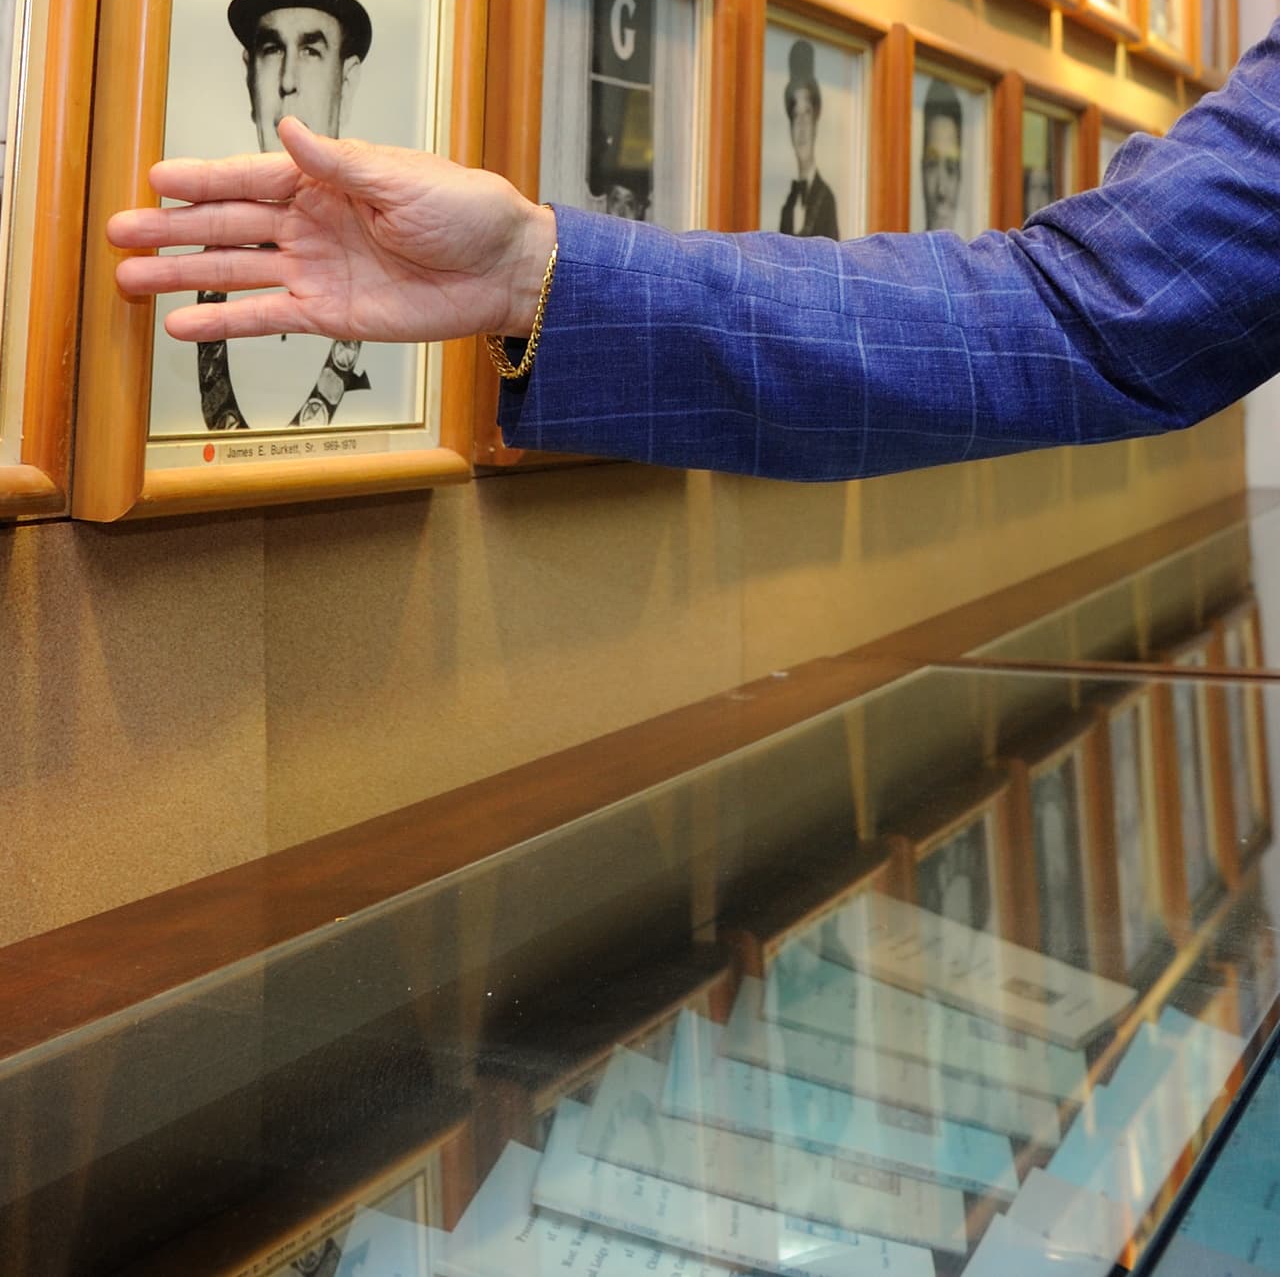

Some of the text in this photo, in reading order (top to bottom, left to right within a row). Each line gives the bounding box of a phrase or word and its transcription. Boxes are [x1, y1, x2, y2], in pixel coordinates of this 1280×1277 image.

[227, 446, 254, 459] James
[258, 444, 266, 457] E.
[305, 442, 317, 453] Sr.
